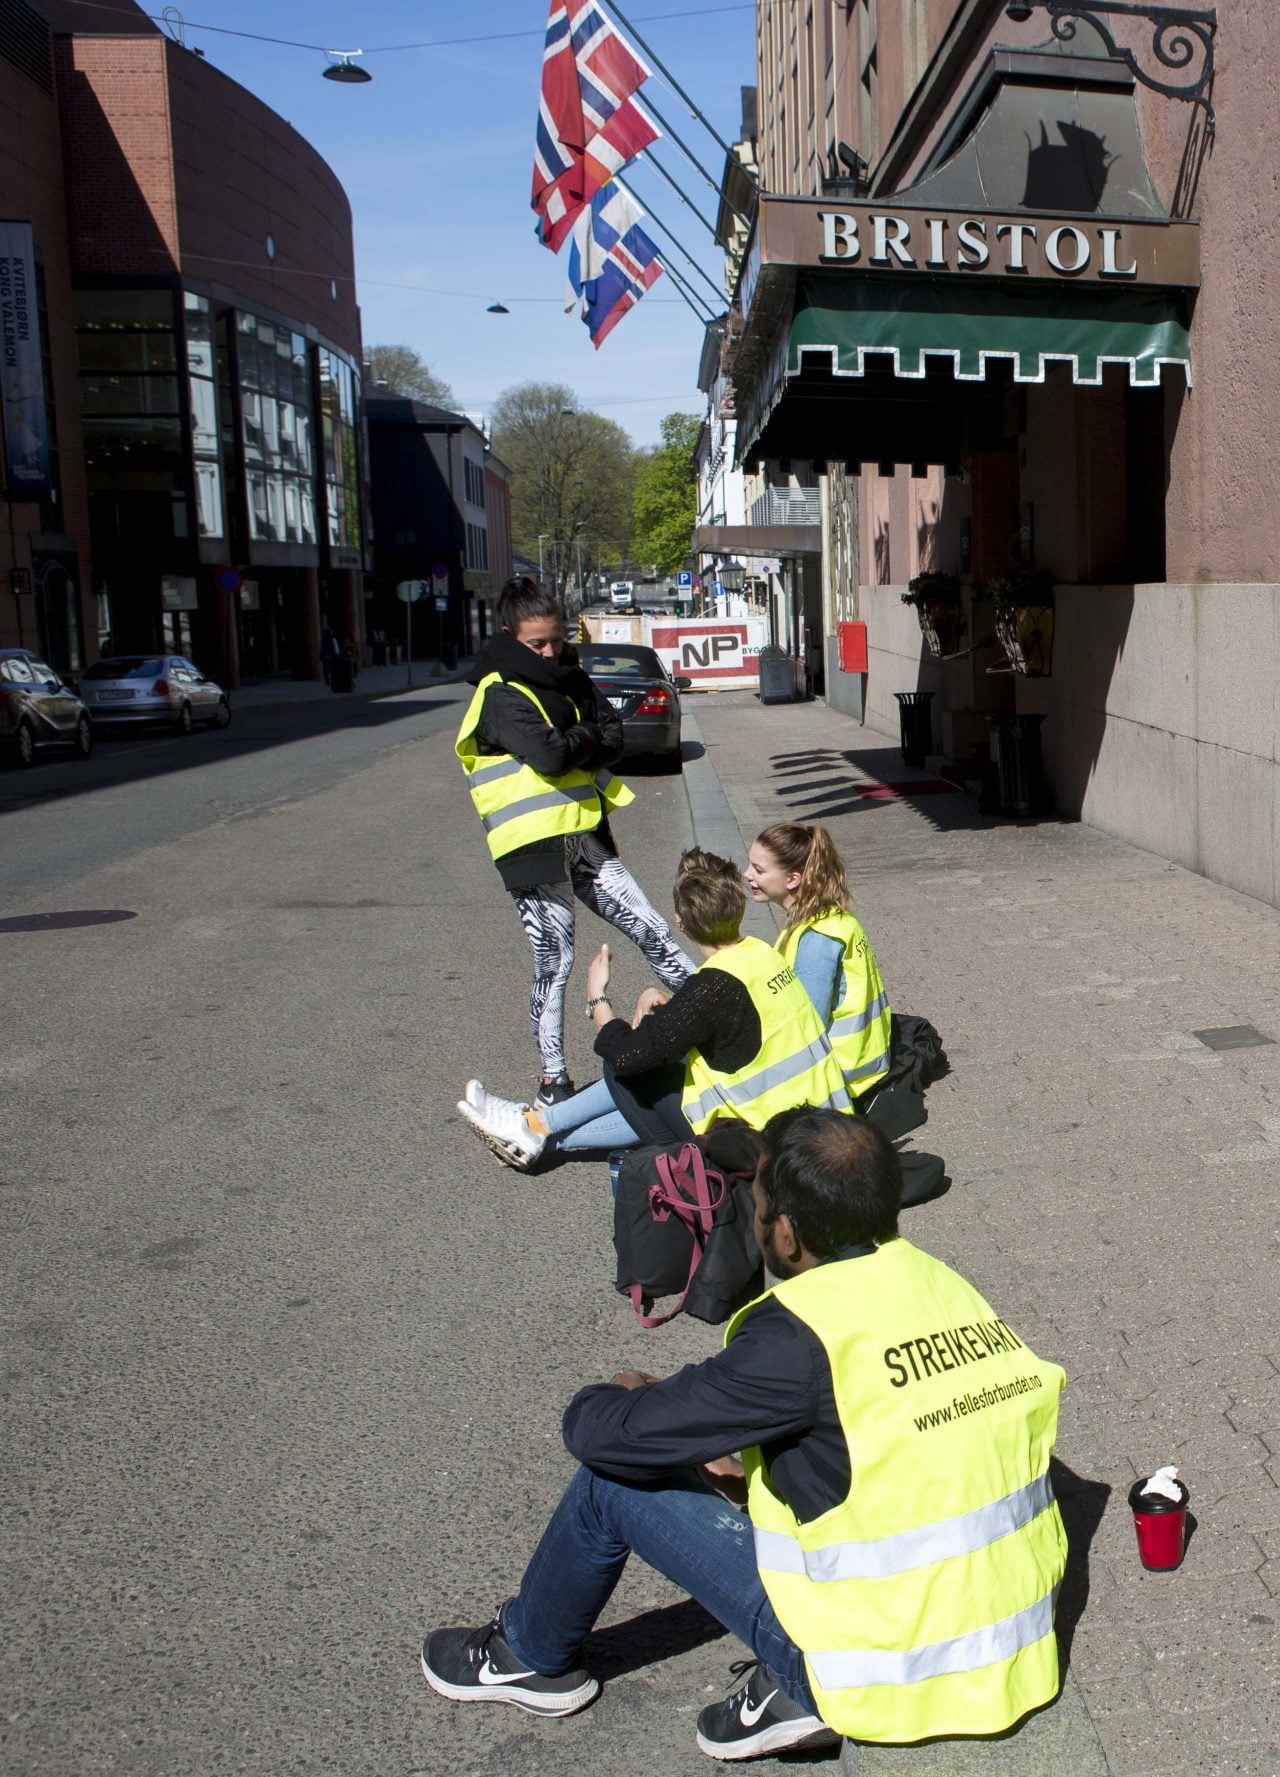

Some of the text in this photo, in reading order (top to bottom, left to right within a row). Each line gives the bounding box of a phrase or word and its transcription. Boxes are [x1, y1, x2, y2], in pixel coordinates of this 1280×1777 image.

[816, 211, 1138, 277] BRISTOL
[0, 257, 17, 368] KONG VALEMON
[12, 257, 30, 342] KVITEBJØRN
[682, 635, 739, 668] NP
[913, 1374, 1043, 1433] www.fellesforbundet.no
